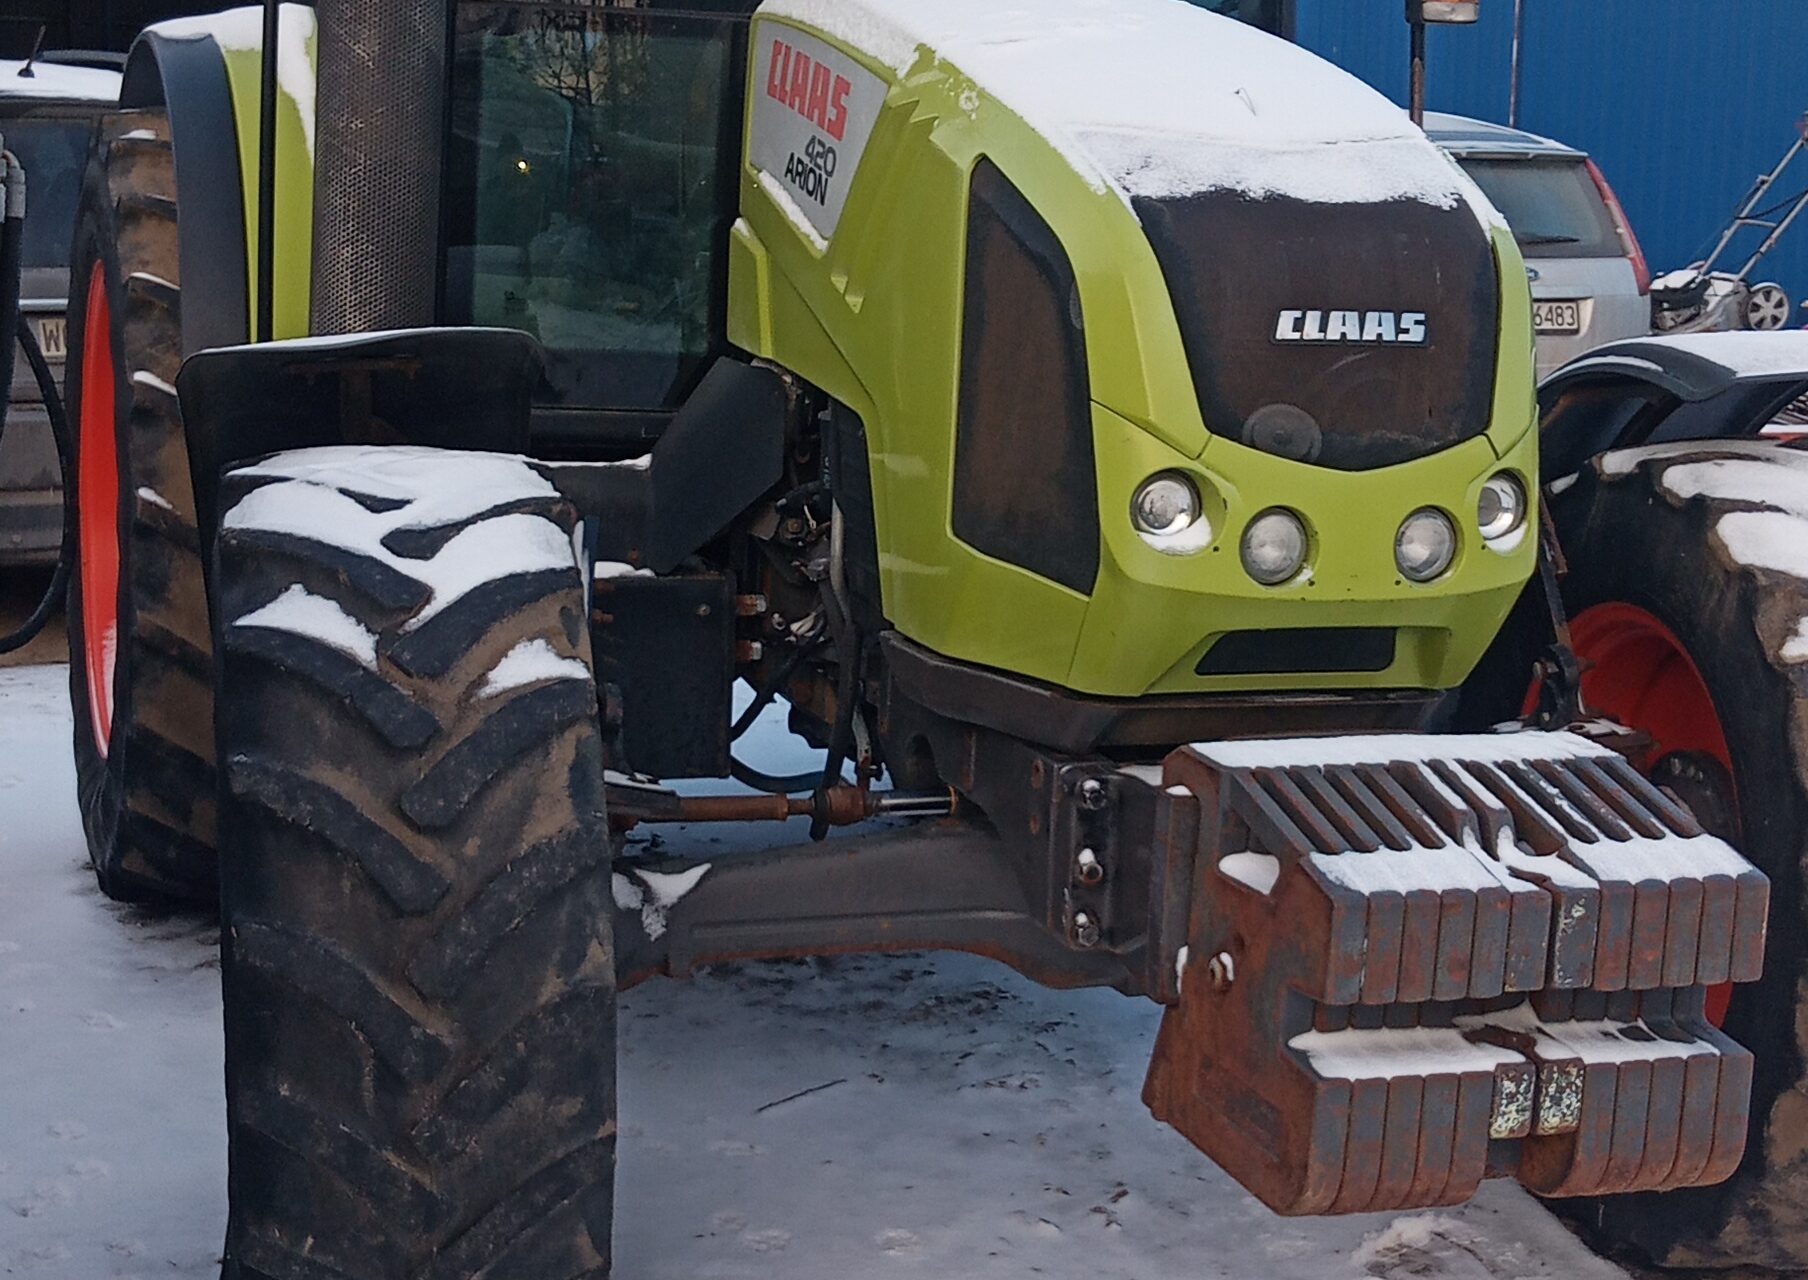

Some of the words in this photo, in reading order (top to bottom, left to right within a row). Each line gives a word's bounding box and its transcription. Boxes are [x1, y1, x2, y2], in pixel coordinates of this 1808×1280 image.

[766, 39, 851, 142] CLAAS
[804, 134, 837, 178] 420
[784, 151, 828, 206] ARION
[1275, 309, 1426, 342] CLAAS
[1533, 304, 1576, 327] 6483
[42, 321, 66, 353] W
